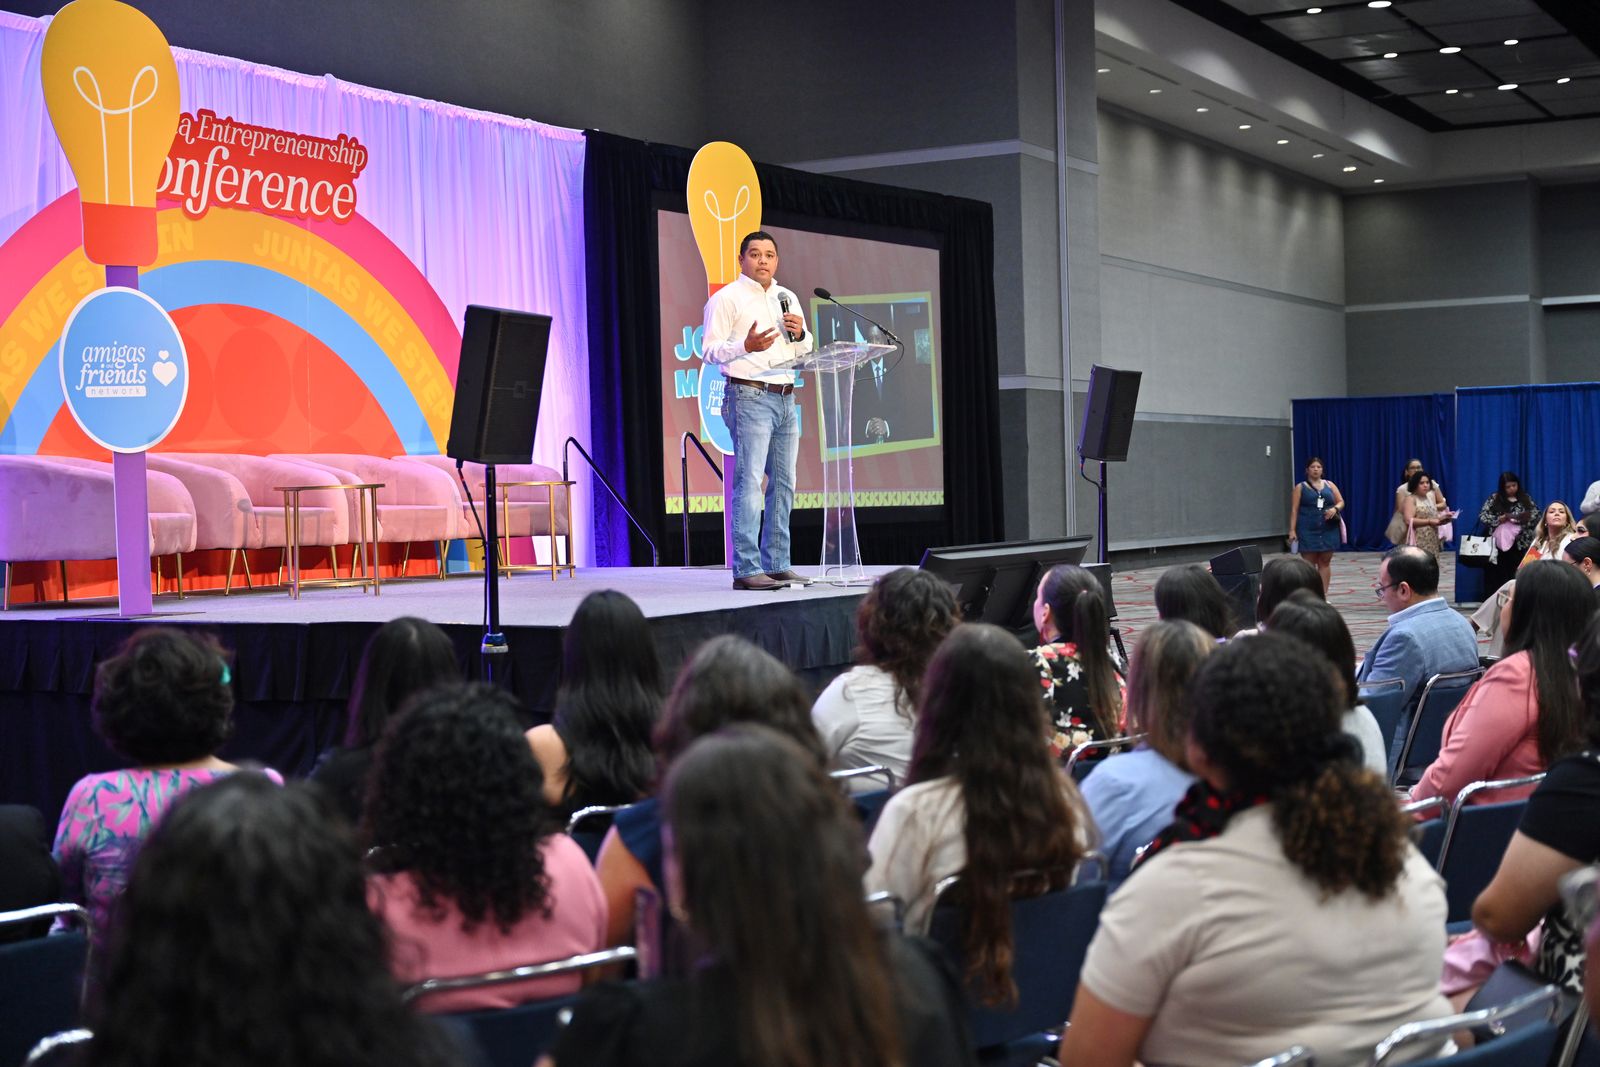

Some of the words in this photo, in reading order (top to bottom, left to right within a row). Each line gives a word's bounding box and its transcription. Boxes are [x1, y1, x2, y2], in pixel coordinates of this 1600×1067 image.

[197, 114, 366, 174] Entrepreneurship
[19, 279, 73, 343] WE
[252, 229, 361, 304] JUNTAS
[363, 290, 404, 347] WE
[401, 341, 450, 421] STEP
[81, 340, 146, 369] amigas
[75, 363, 147, 391] friends
[91, 388, 139, 396] network
